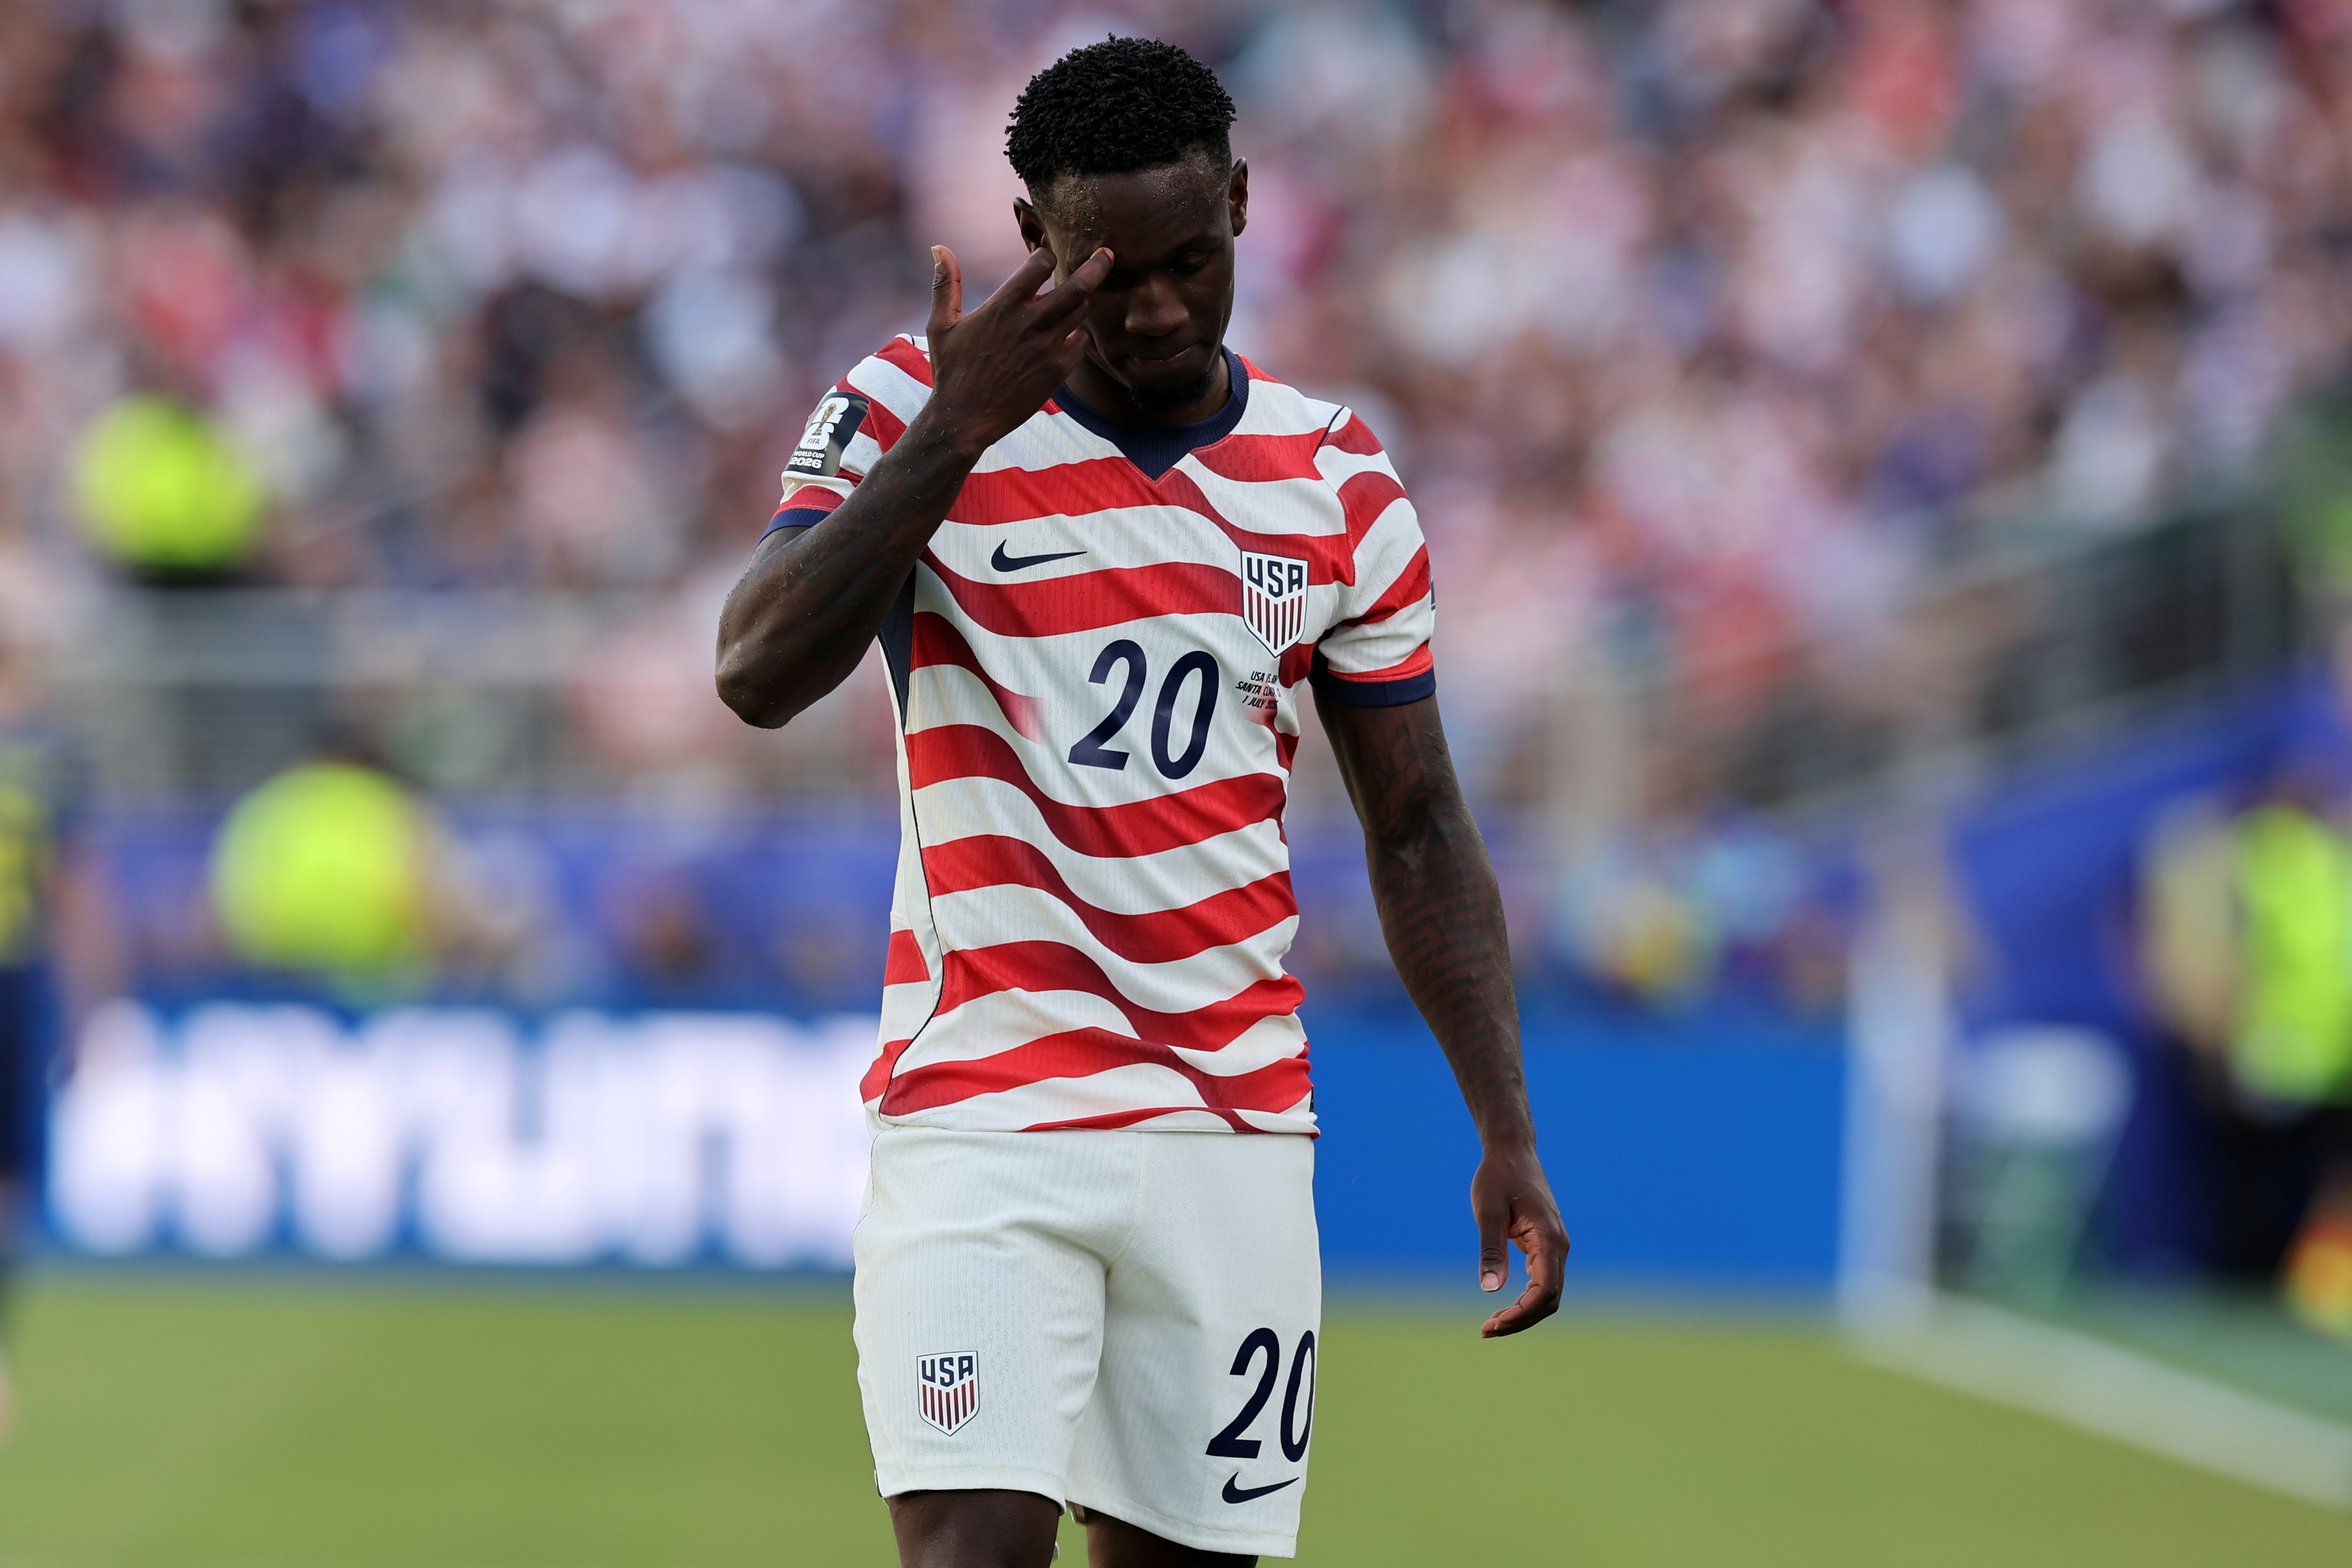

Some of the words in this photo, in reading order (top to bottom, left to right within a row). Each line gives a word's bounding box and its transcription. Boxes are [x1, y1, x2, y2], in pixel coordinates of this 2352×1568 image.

[789, 457, 822, 469] 2026
[1246, 557, 1303, 598] USA
[1235, 681, 1262, 695] SANTA
[1250, 671, 1265, 682] USA
[1067, 639, 1219, 780] 20
[1242, 695, 1249, 704] 1
[1247, 697, 1266, 708] JULY
[921, 1355, 973, 1387] USA
[1205, 1327, 1315, 1462] 20
